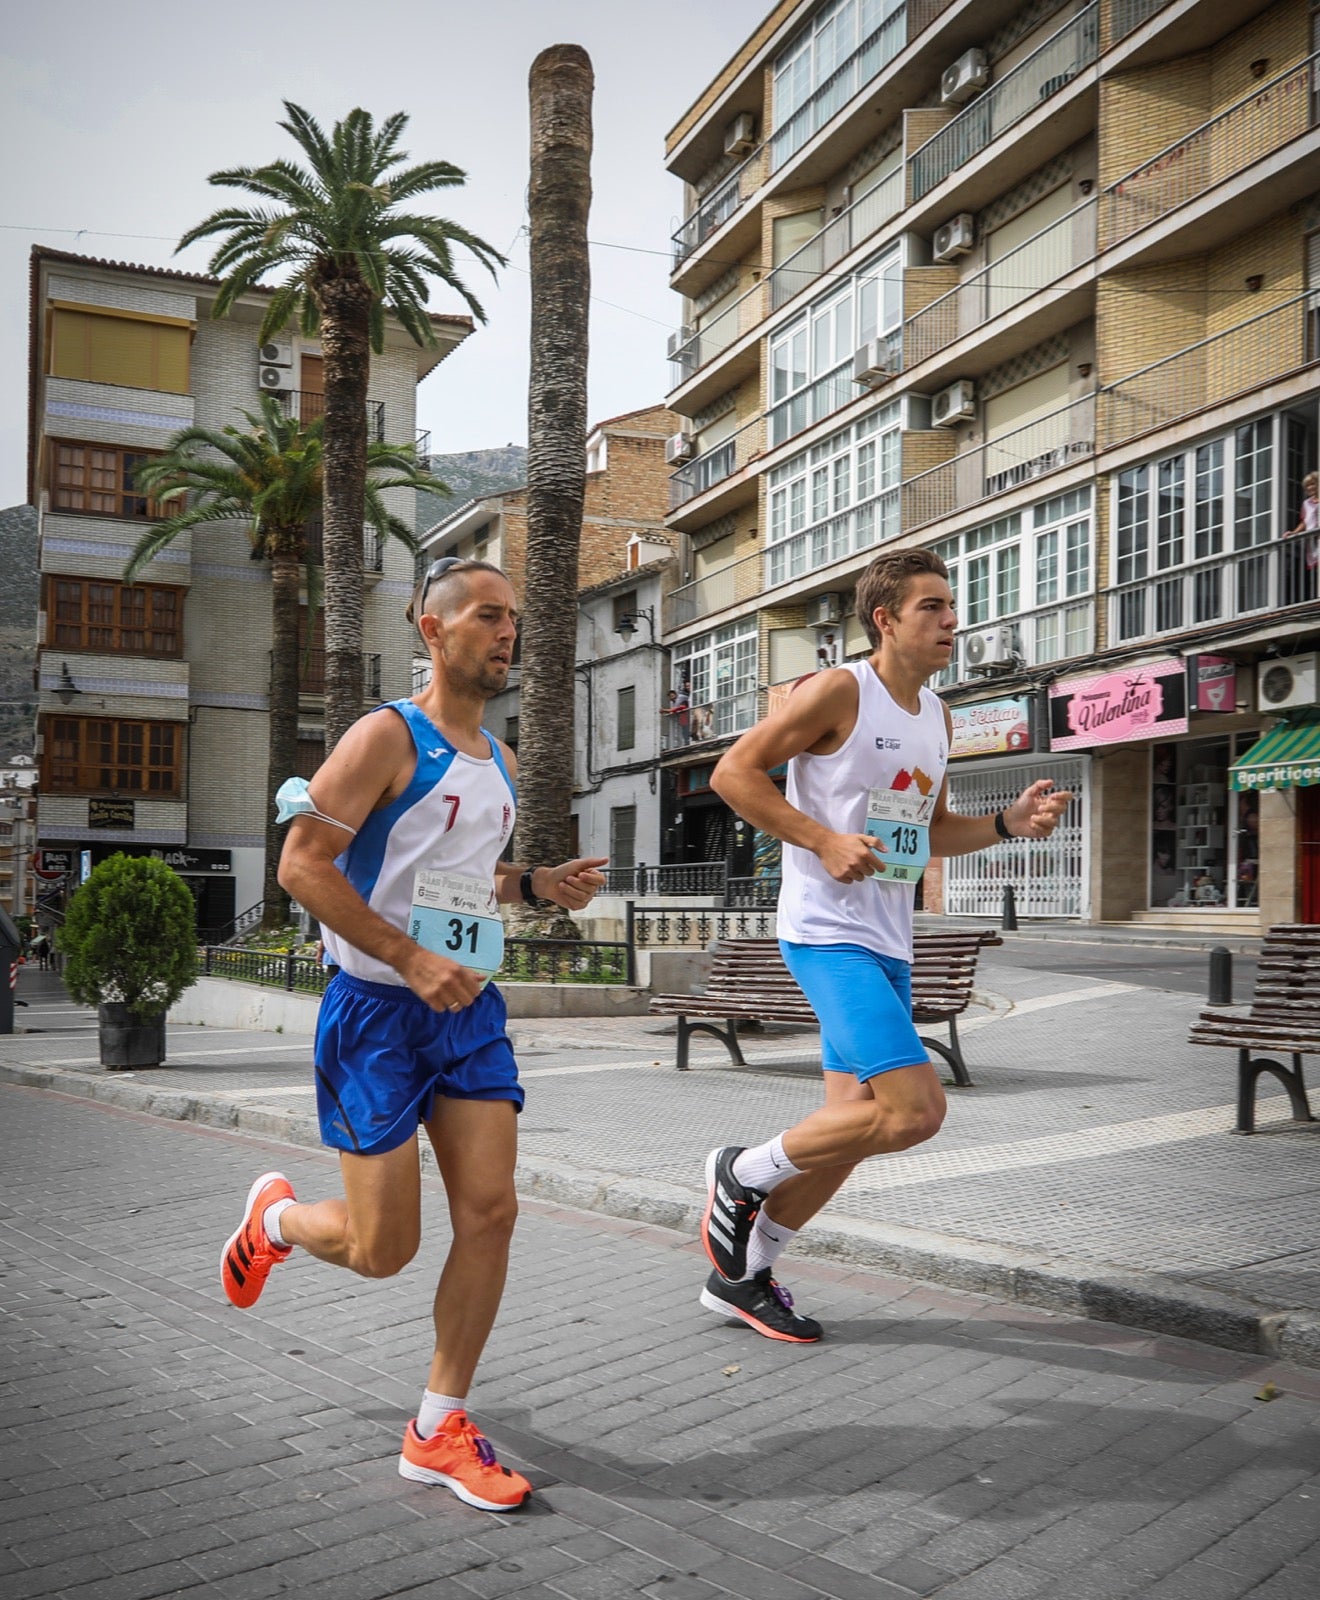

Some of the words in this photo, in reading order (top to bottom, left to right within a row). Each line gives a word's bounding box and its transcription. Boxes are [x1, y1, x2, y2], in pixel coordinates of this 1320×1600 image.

[1078, 689, 1151, 731] Valentina
[442, 794, 461, 834] 7
[891, 826, 918, 855] 133
[410, 919, 422, 944] ENIOR
[445, 918, 480, 953] 31
